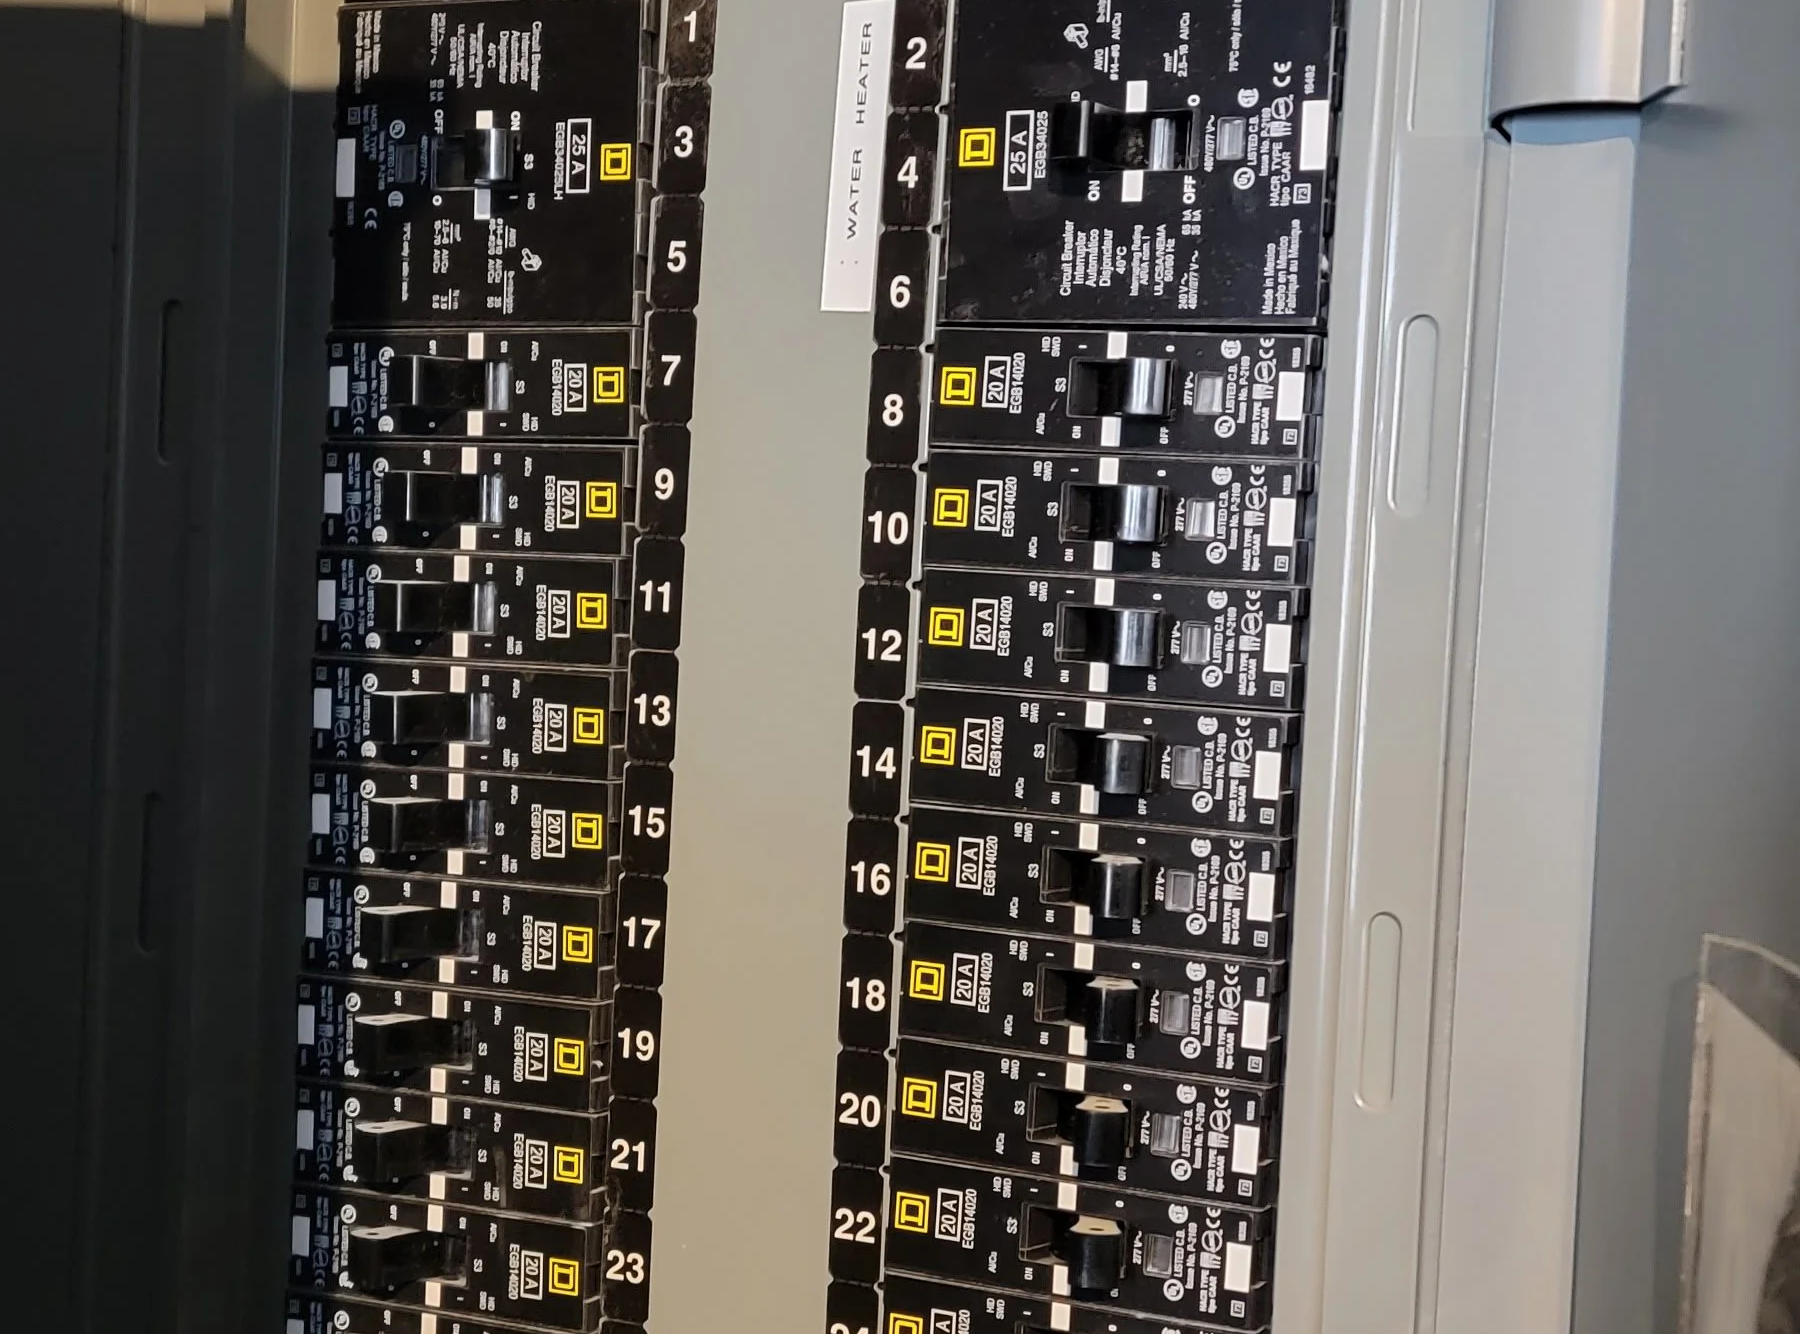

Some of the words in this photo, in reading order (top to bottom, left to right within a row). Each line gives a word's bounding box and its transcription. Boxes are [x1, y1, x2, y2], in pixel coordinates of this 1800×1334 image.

[684, 11, 696, 42] 1
[906, 37, 927, 69] 2
[434, 109, 444, 135] OFF
[510, 110, 521, 131] ON
[846, 148, 864, 240] WATER
[855, 21, 872, 124] HEATER
[674, 126, 693, 157] 3
[1010, 130, 1028, 146] A
[1034, 111, 1048, 178] EGB34025
[898, 156, 918, 188] 4
[1009, 150, 1027, 175] 25
[1087, 179, 1100, 202] ON
[1183, 175, 1197, 205] OFF
[1061, 220, 1075, 261] Breaker
[667, 241, 686, 272] 5
[890, 275, 910, 308] 6
[1059, 262, 1073, 297] Circuit
[662, 355, 681, 385] 7
[989, 365, 1006, 379] A
[1009, 352, 1025, 413] EGB14020
[987, 381, 1004, 402] 20
[883, 394, 903, 426] 8
[655, 468, 674, 500] 9
[981, 489, 998, 502] A
[979, 504, 997, 525] 20
[1002, 477, 1017, 537] EGB14020
[868, 511, 908, 544] 10
[640, 581, 670, 612] 11
[976, 608, 993, 622] A
[997, 596, 1012, 656] EGB14020
[862, 628, 901, 661] 12
[975, 623, 992, 644] 20
[634, 694, 670, 726] 13
[968, 728, 985, 742] A
[989, 716, 1004, 776] EGB14020
[857, 746, 896, 779] 14
[966, 743, 983, 764] 20
[629, 805, 664, 838] 15
[962, 847, 979, 861] A
[983, 836, 998, 896] EGB14020
[851, 861, 890, 895] 16
[961, 862, 978, 883] 20
[623, 917, 660, 948] 17
[957, 964, 974, 977] A
[978, 953, 993, 1013] EGB14020
[847, 977, 885, 1011] 18
[955, 979, 973, 1000] 20
[618, 1028, 654, 1061] 19
[949, 1081, 965, 1095] A
[970, 1071, 984, 1131] EGB14020
[839, 1093, 880, 1127] 20
[947, 1096, 964, 1117] 20
[611, 1139, 644, 1172] 21
[942, 1199, 958, 1213] A
[962, 1189, 977, 1249] EGB14020
[834, 1208, 875, 1243] 22
[940, 1214, 957, 1235] 20
[606, 1250, 644, 1283] 23
[935, 1320, 951, 1333] A
